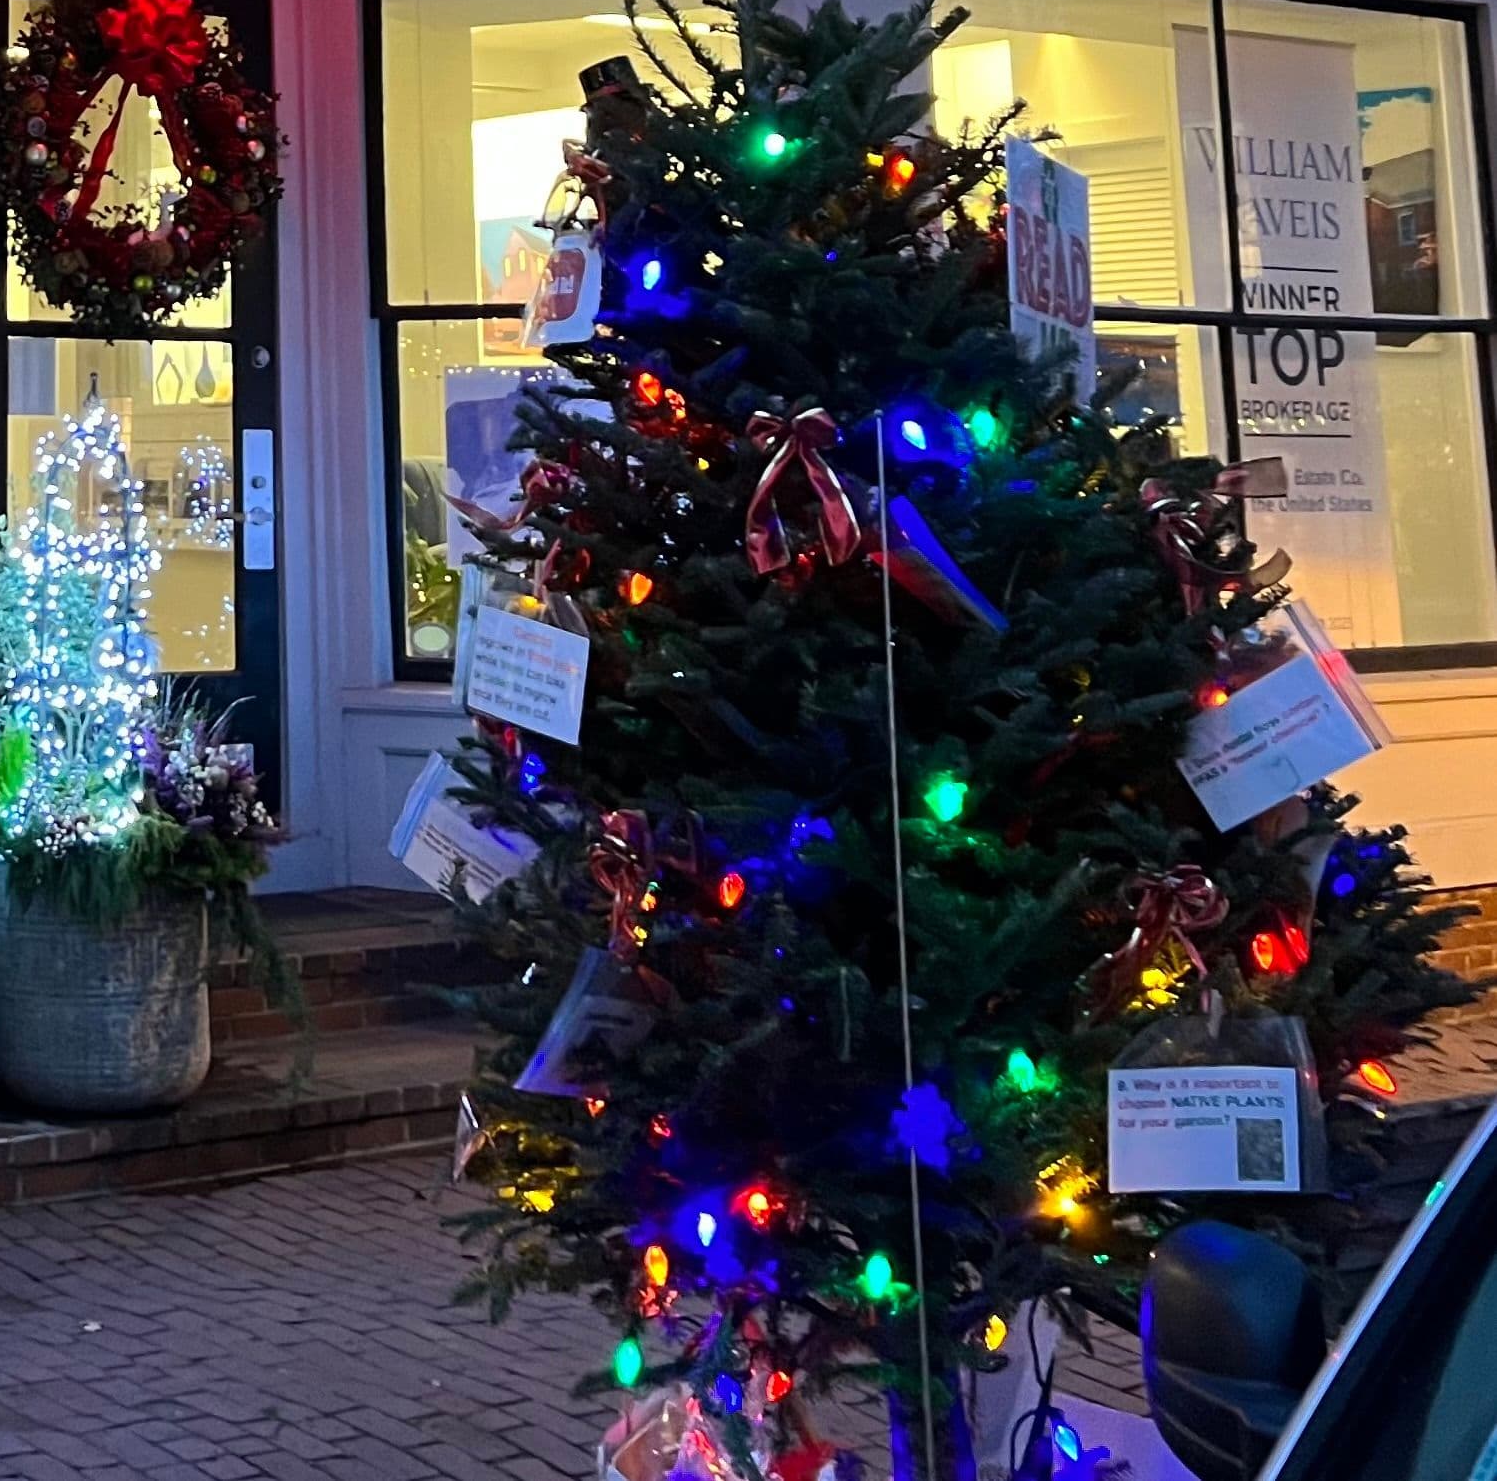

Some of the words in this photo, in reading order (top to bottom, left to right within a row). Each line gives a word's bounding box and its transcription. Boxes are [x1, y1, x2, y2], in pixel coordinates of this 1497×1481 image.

[1250, 197, 1341, 241] AVEIS
[1235, 325, 1346, 387] TOP
[1240, 399, 1352, 422] BROKERAGE
[1225, 1094, 1286, 1109] PLANTS
